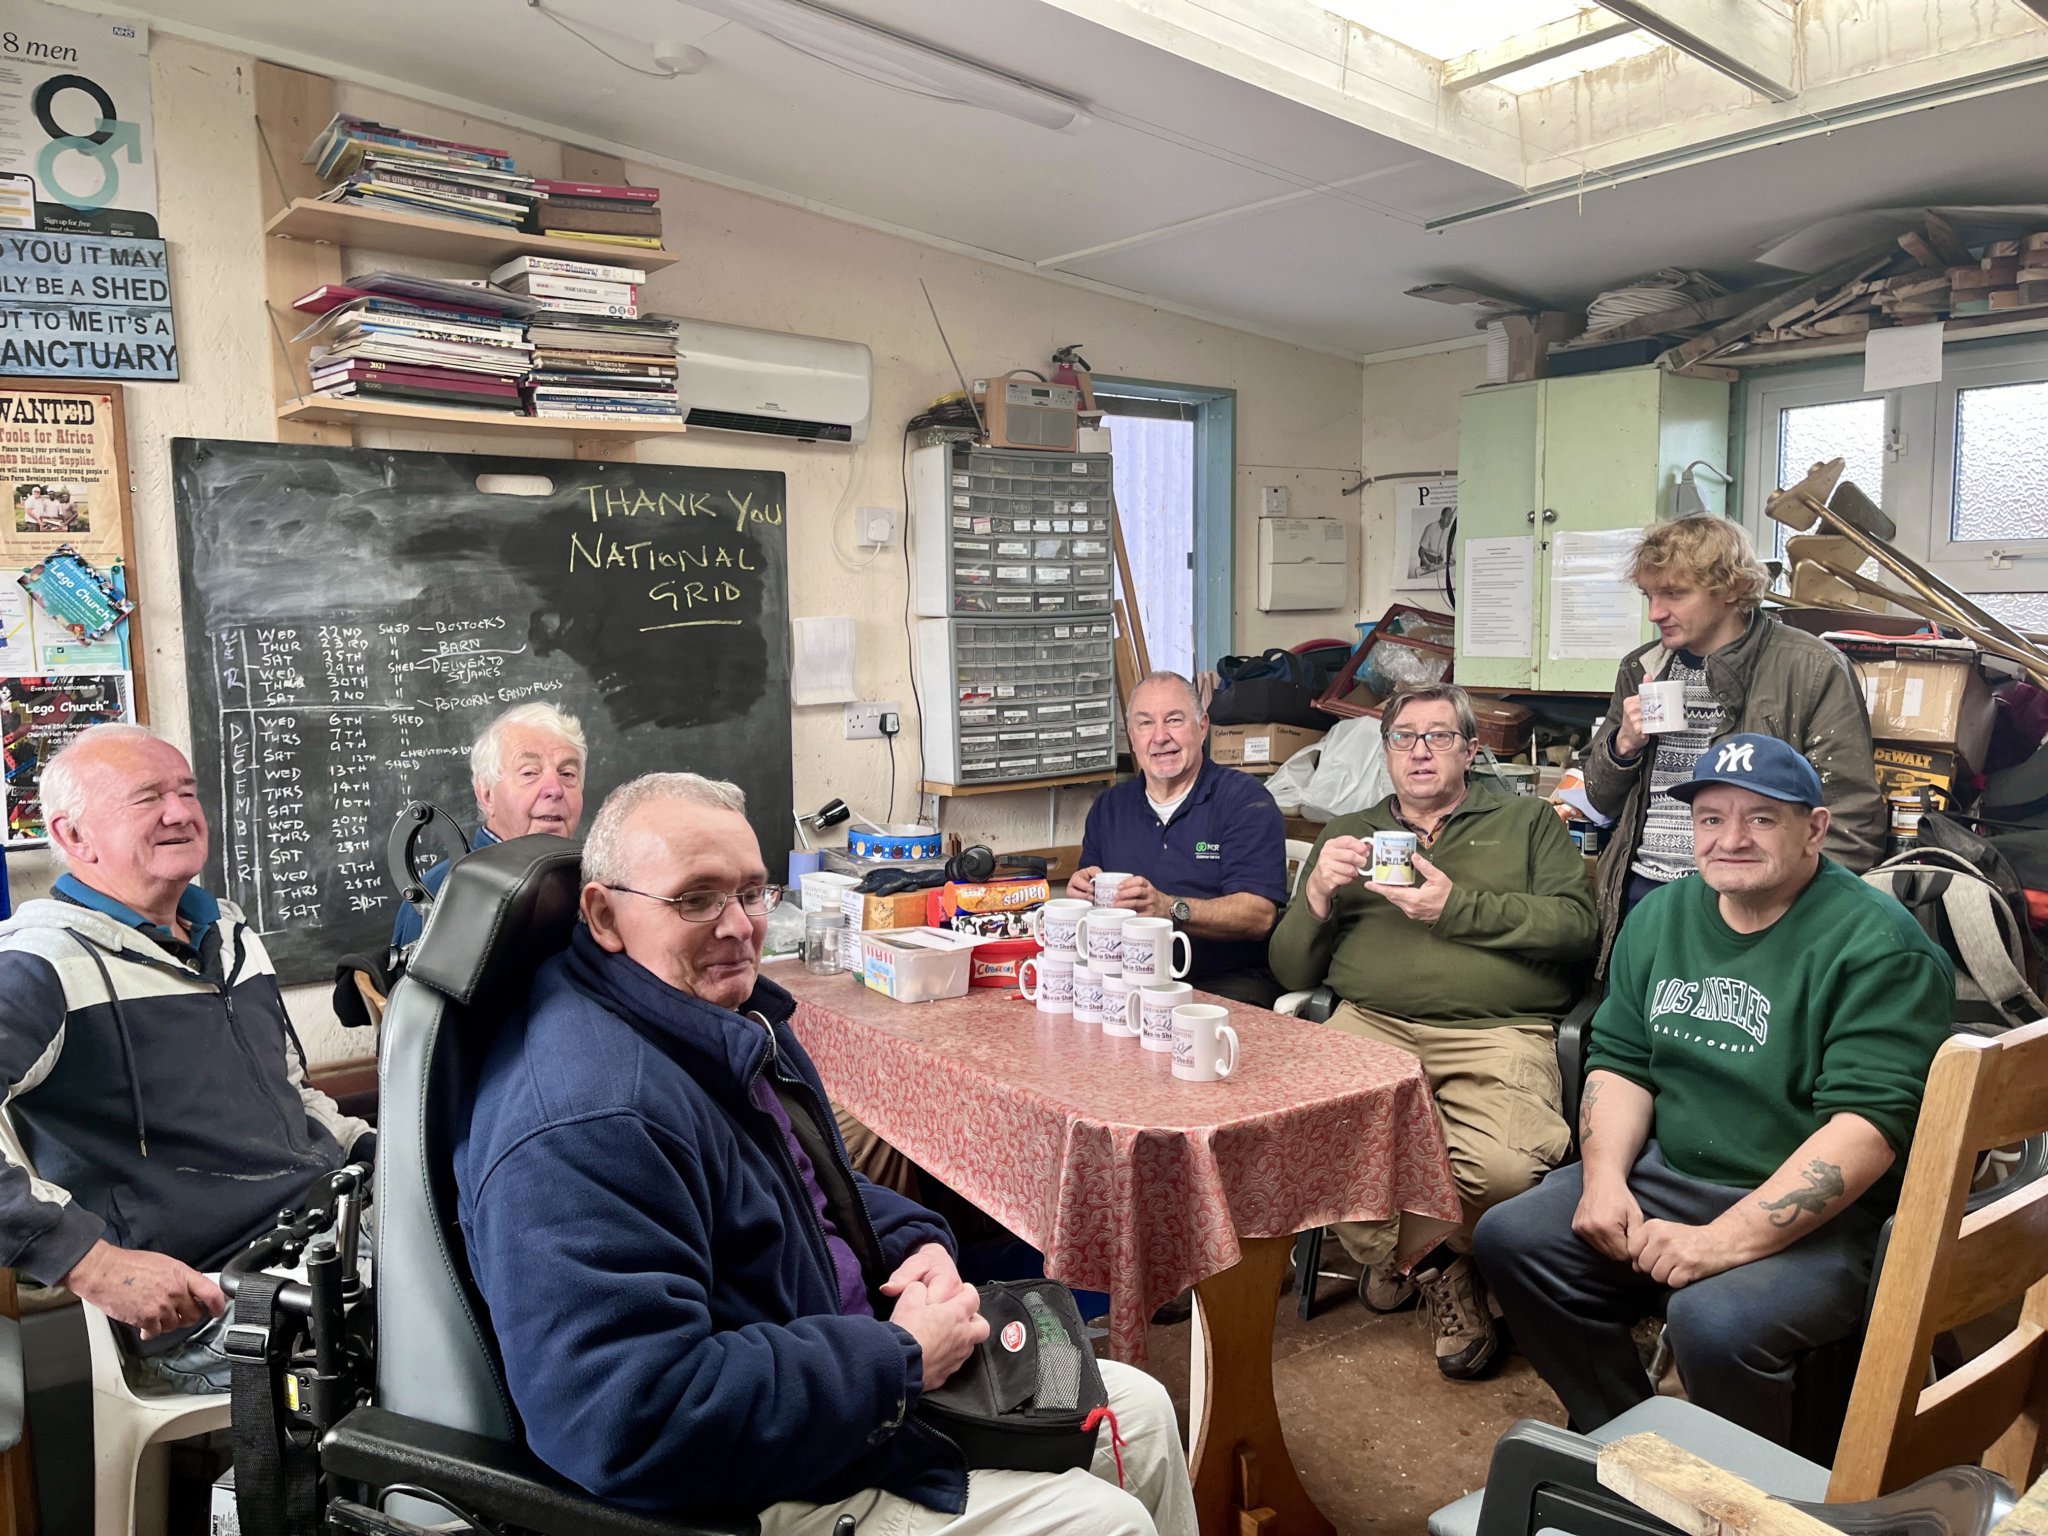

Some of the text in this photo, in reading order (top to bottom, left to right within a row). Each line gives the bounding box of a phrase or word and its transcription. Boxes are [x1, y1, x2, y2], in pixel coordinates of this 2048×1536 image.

[113, 27, 135, 38] NHS
[26, 41, 78, 62] men
[392, 175, 413, 186] OTHER
[413, 178, 428, 188] SIDE
[428, 182, 438, 190] OF
[9, 238, 164, 269] YOU IT MAY
[36, 275, 168, 302] BE A SHED
[29, 310, 170, 335] TO ME IT'S A
[370, 361, 386, 370] 2021
[34, 428, 52, 444] for
[56, 429, 94, 445] Africa
[20, 454, 95, 468] Building Supplies
[578, 484, 717, 523] THANK
[1418, 487, 1429, 506] P
[569, 532, 755, 573] NATIONAL
[649, 580, 742, 612] GRID
[257, 628, 297, 643] WED
[261, 655, 294, 667] SAT
[438, 638, 481, 655] BARN
[259, 668, 296, 680] WED
[388, 662, 416, 675] SHED
[264, 694, 297, 707] SAT
[258, 716, 296, 729] WED
[392, 714, 424, 728] SHED
[263, 749, 296, 763] SAT
[264, 769, 302, 782] WED
[385, 759, 420, 771] SHED
[267, 803, 304, 819] SAT
[268, 820, 305, 832] WED
[269, 848, 303, 864] SAT
[272, 870, 308, 883] WED
[278, 904, 321, 921] SAT
[1650, 976, 1771, 1046] LOS ANGELES
[1653, 1023, 1755, 1053] CALIFORNIA
